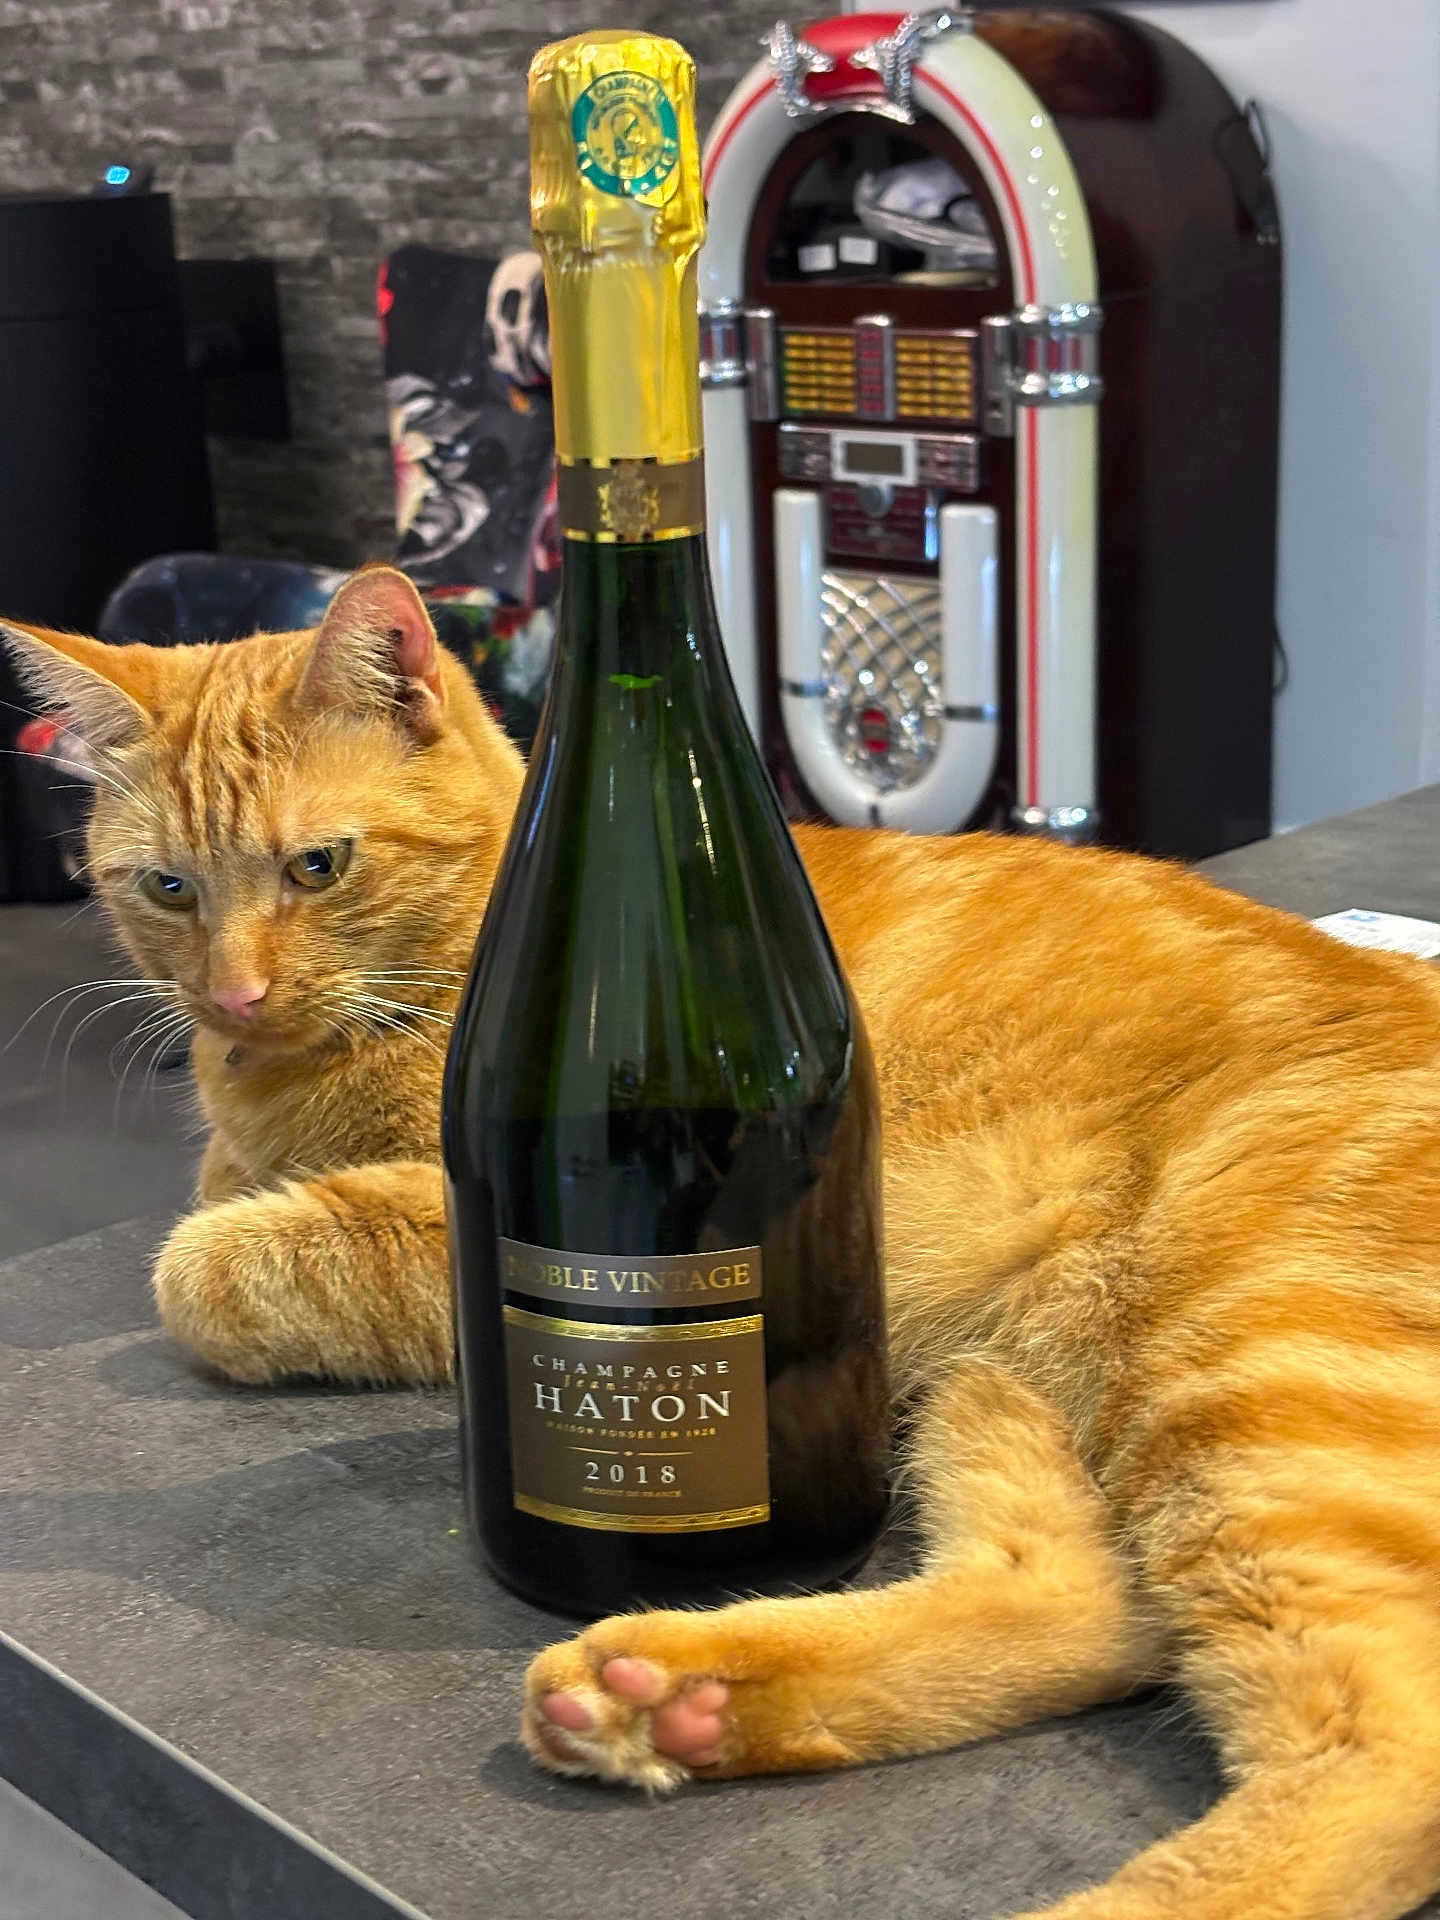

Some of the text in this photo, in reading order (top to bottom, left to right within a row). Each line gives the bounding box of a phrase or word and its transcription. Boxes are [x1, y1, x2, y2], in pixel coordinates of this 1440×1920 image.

[606, 1263, 750, 1294] VINTAGE
[532, 1354, 729, 1378] CHAMPAGNE
[534, 1383, 732, 1422] HATON
[585, 1462, 676, 1484] 2018
